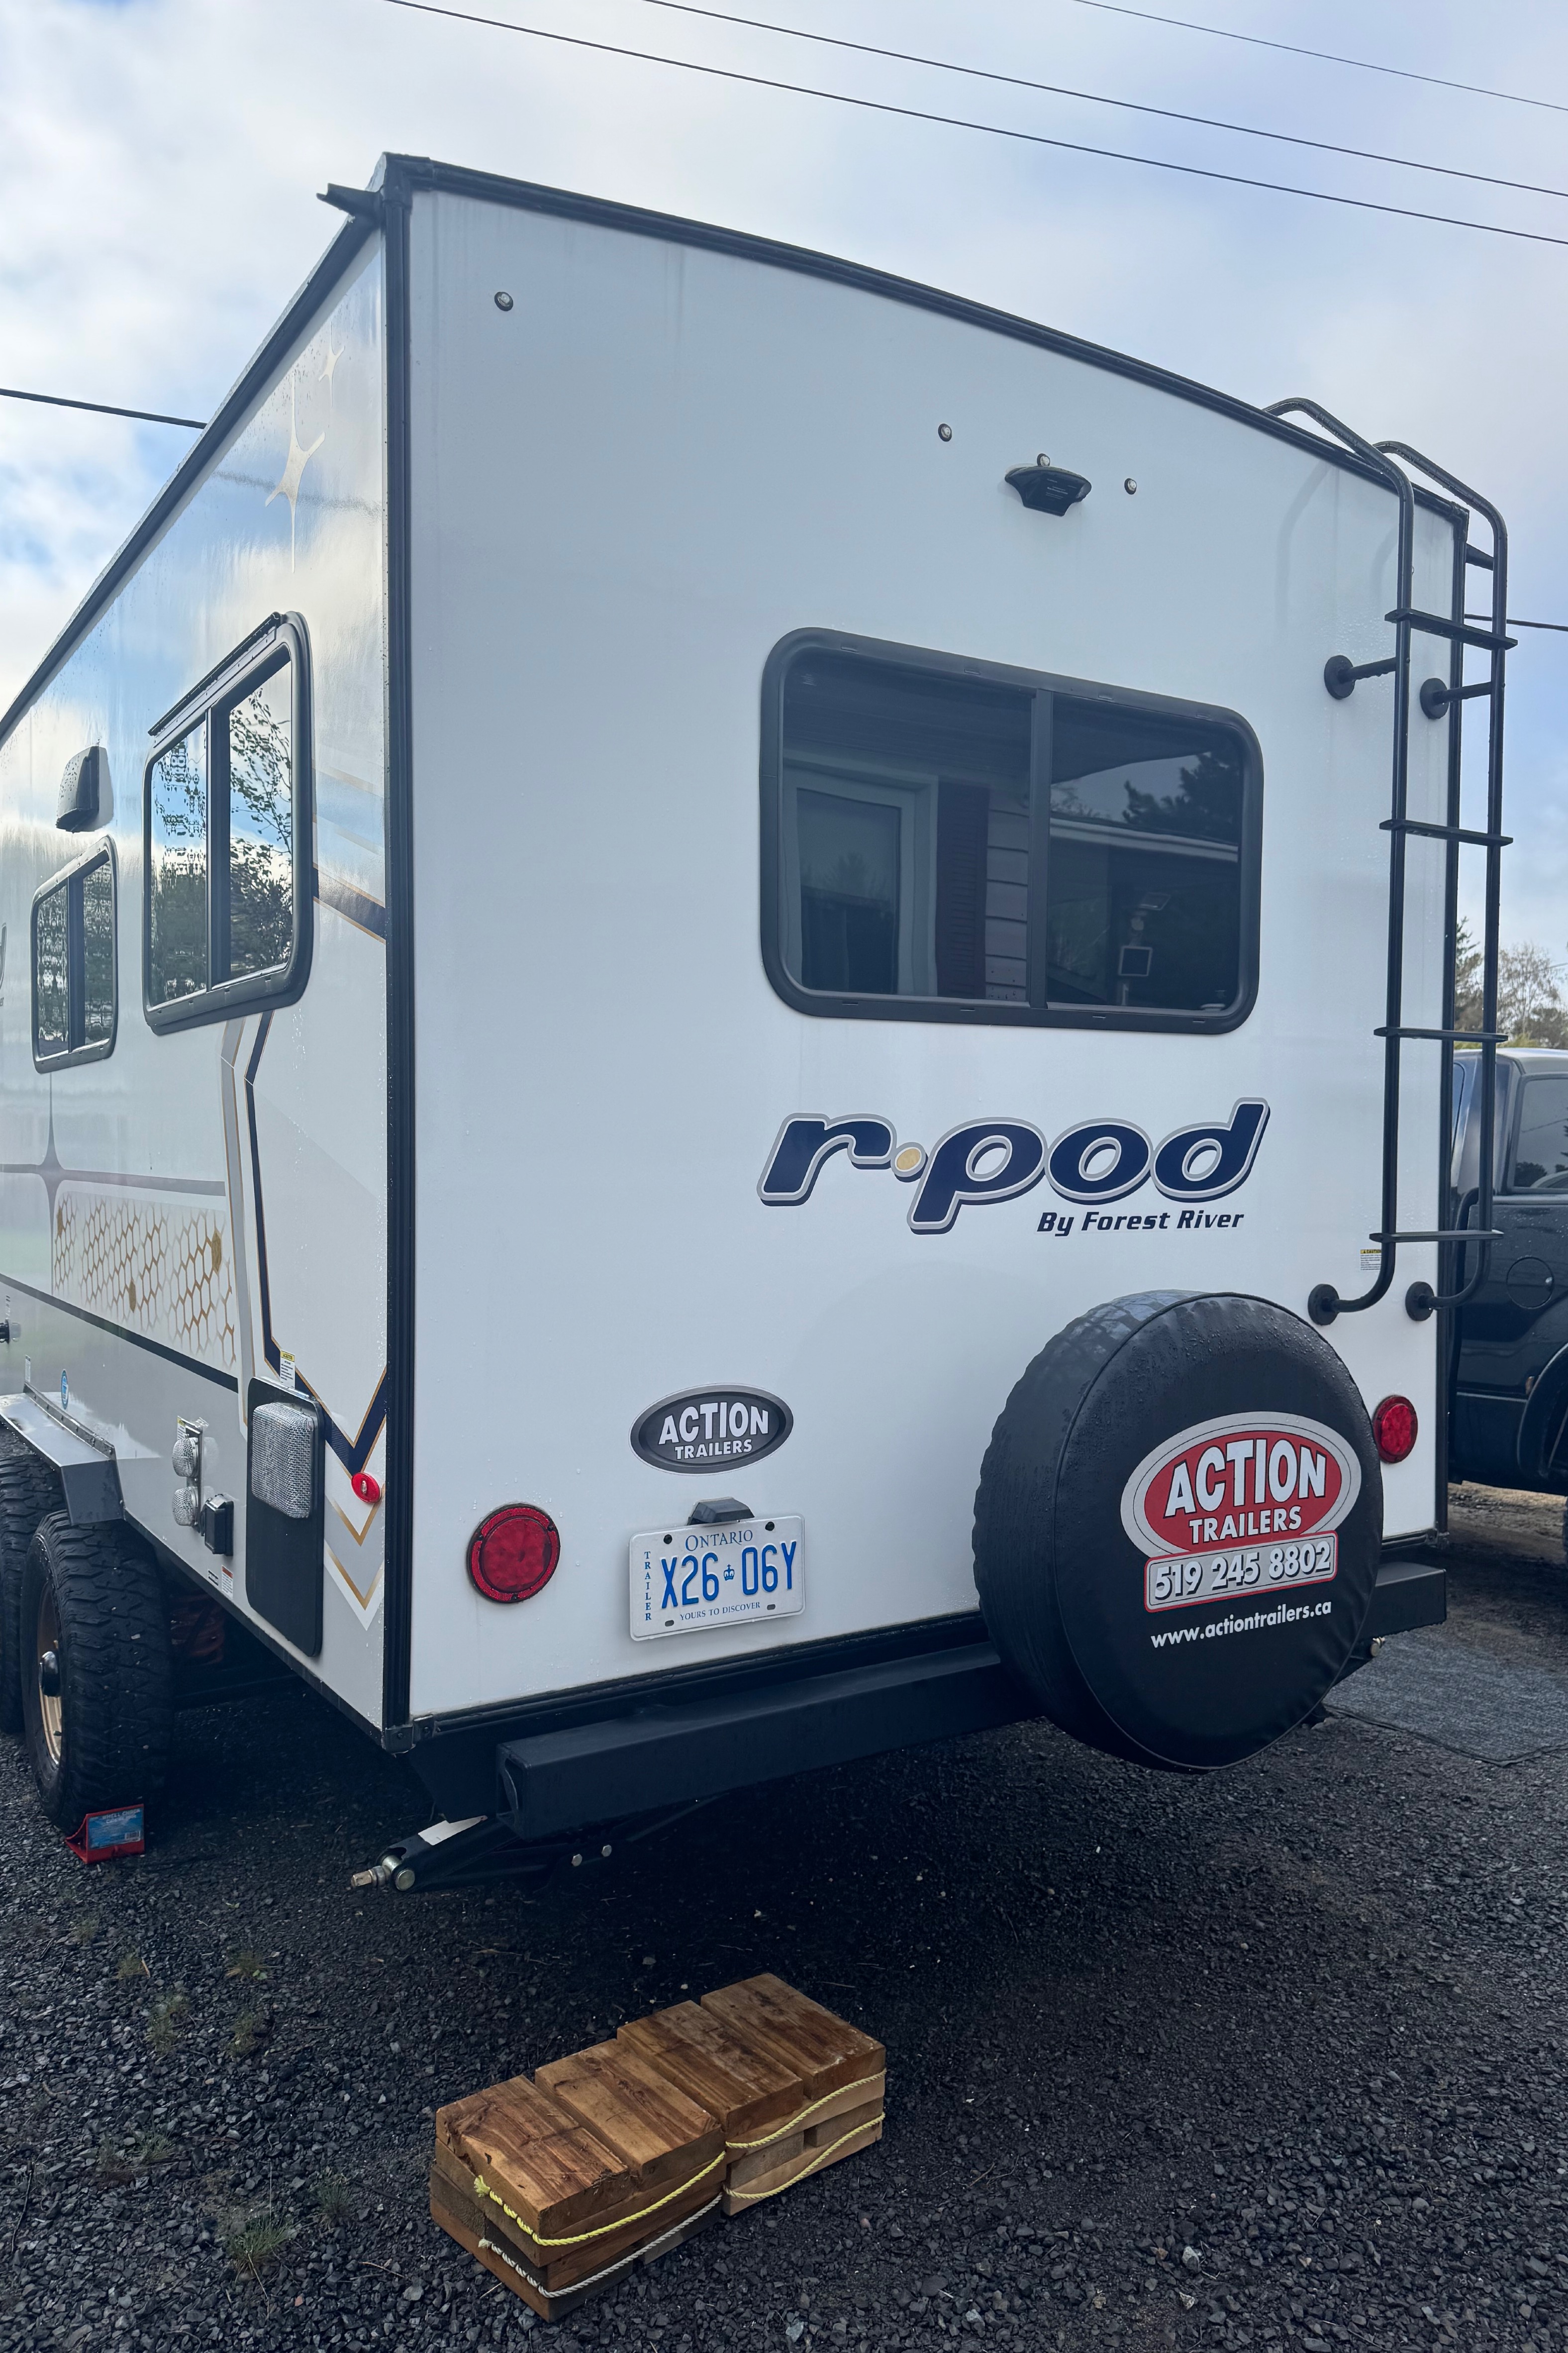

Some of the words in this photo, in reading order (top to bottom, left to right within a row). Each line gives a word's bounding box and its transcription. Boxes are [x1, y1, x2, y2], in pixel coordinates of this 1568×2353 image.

[1037, 1212, 1074, 1237] By
[1081, 1212, 1171, 1231] Forest
[1176, 1210, 1244, 1228] River
[659, 1402, 768, 1445] ACTION
[675, 1439, 752, 1460] TRAILERS
[1163, 1438, 1327, 1519] ACTION
[686, 1530, 753, 1551] ONTARIO
[1189, 1506, 1302, 1544] TRAILERS
[661, 1552, 719, 1609] X26
[742, 1541, 797, 1596] 06Y
[1155, 1560, 1203, 1600] 519
[1211, 1551, 1260, 1591] 245
[1268, 1541, 1331, 1581] 8802
[680, 1610, 706, 1621] YOURS
[708, 1608, 720, 1616] TO
[722, 1601, 760, 1614] DISCOVER
[1150, 1601, 1332, 1648] www.actiontrailers.ca
